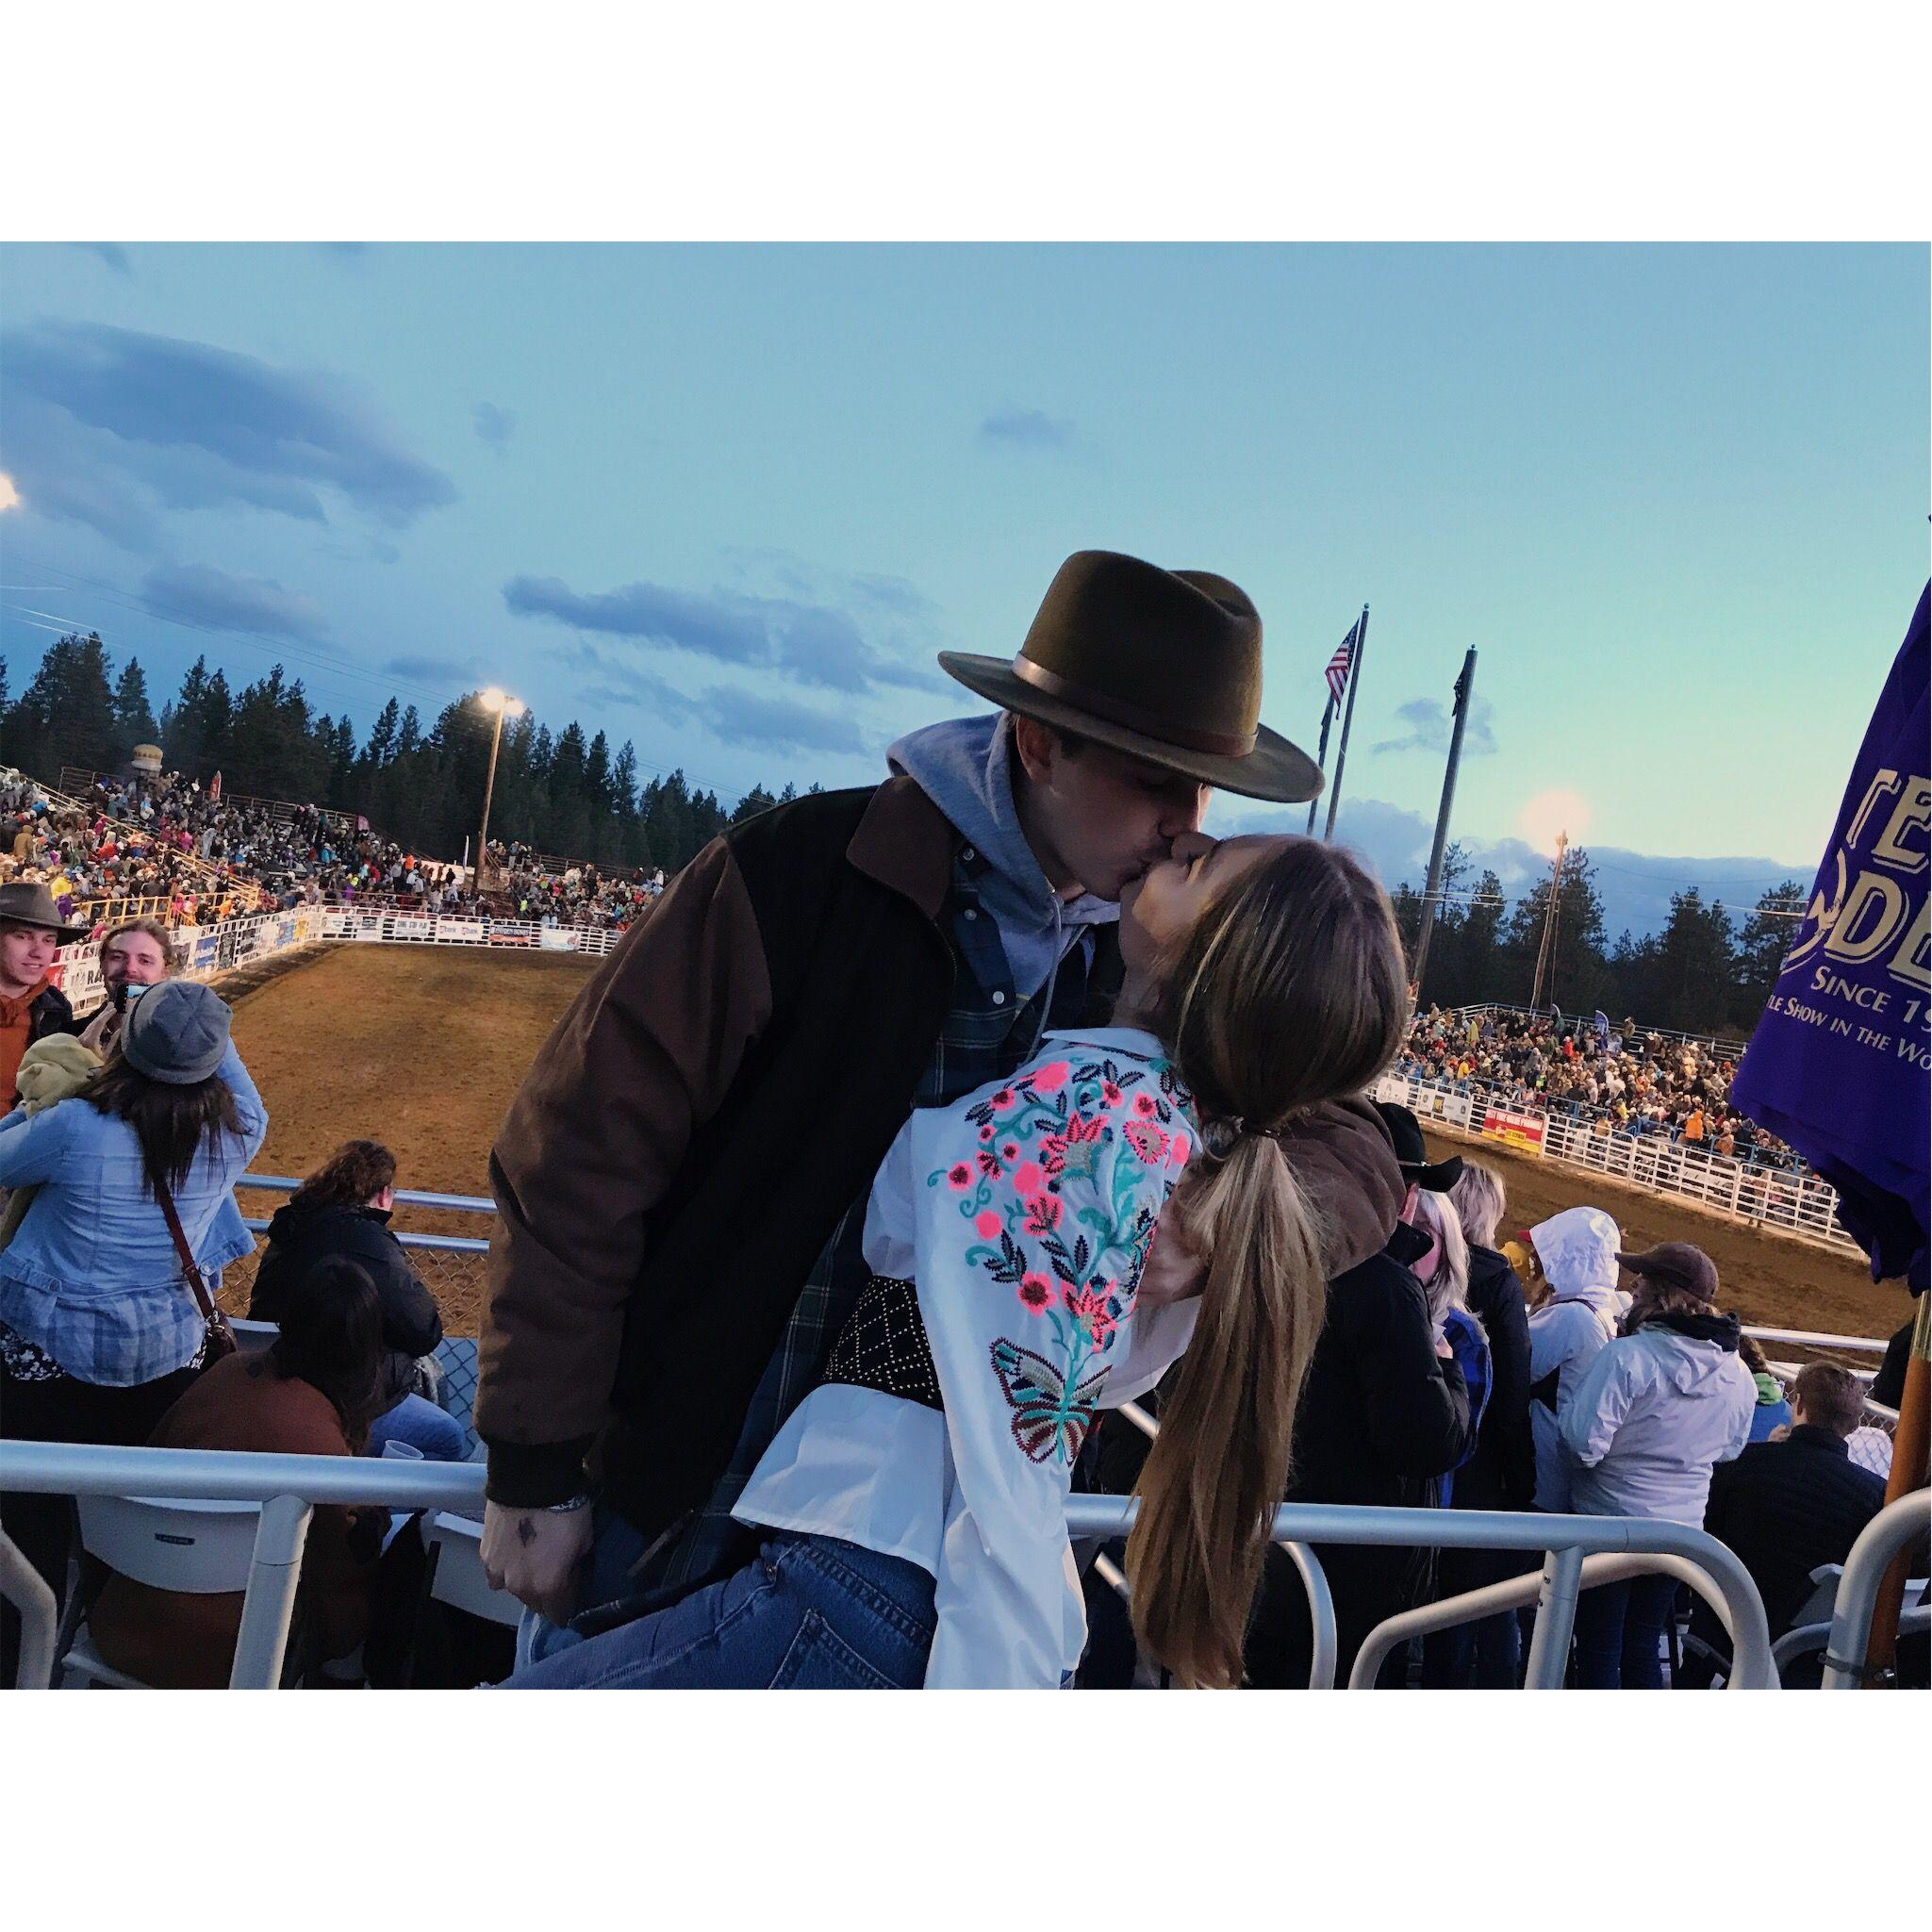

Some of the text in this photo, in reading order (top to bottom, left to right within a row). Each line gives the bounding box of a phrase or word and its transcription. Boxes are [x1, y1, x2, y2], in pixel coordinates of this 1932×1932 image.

[1810, 966, 1891, 1013] SINCE
[1784, 997, 1828, 1026] SHOW
[1829, 1017, 1853, 1037] IN
[1856, 1026, 1891, 1051] THE
